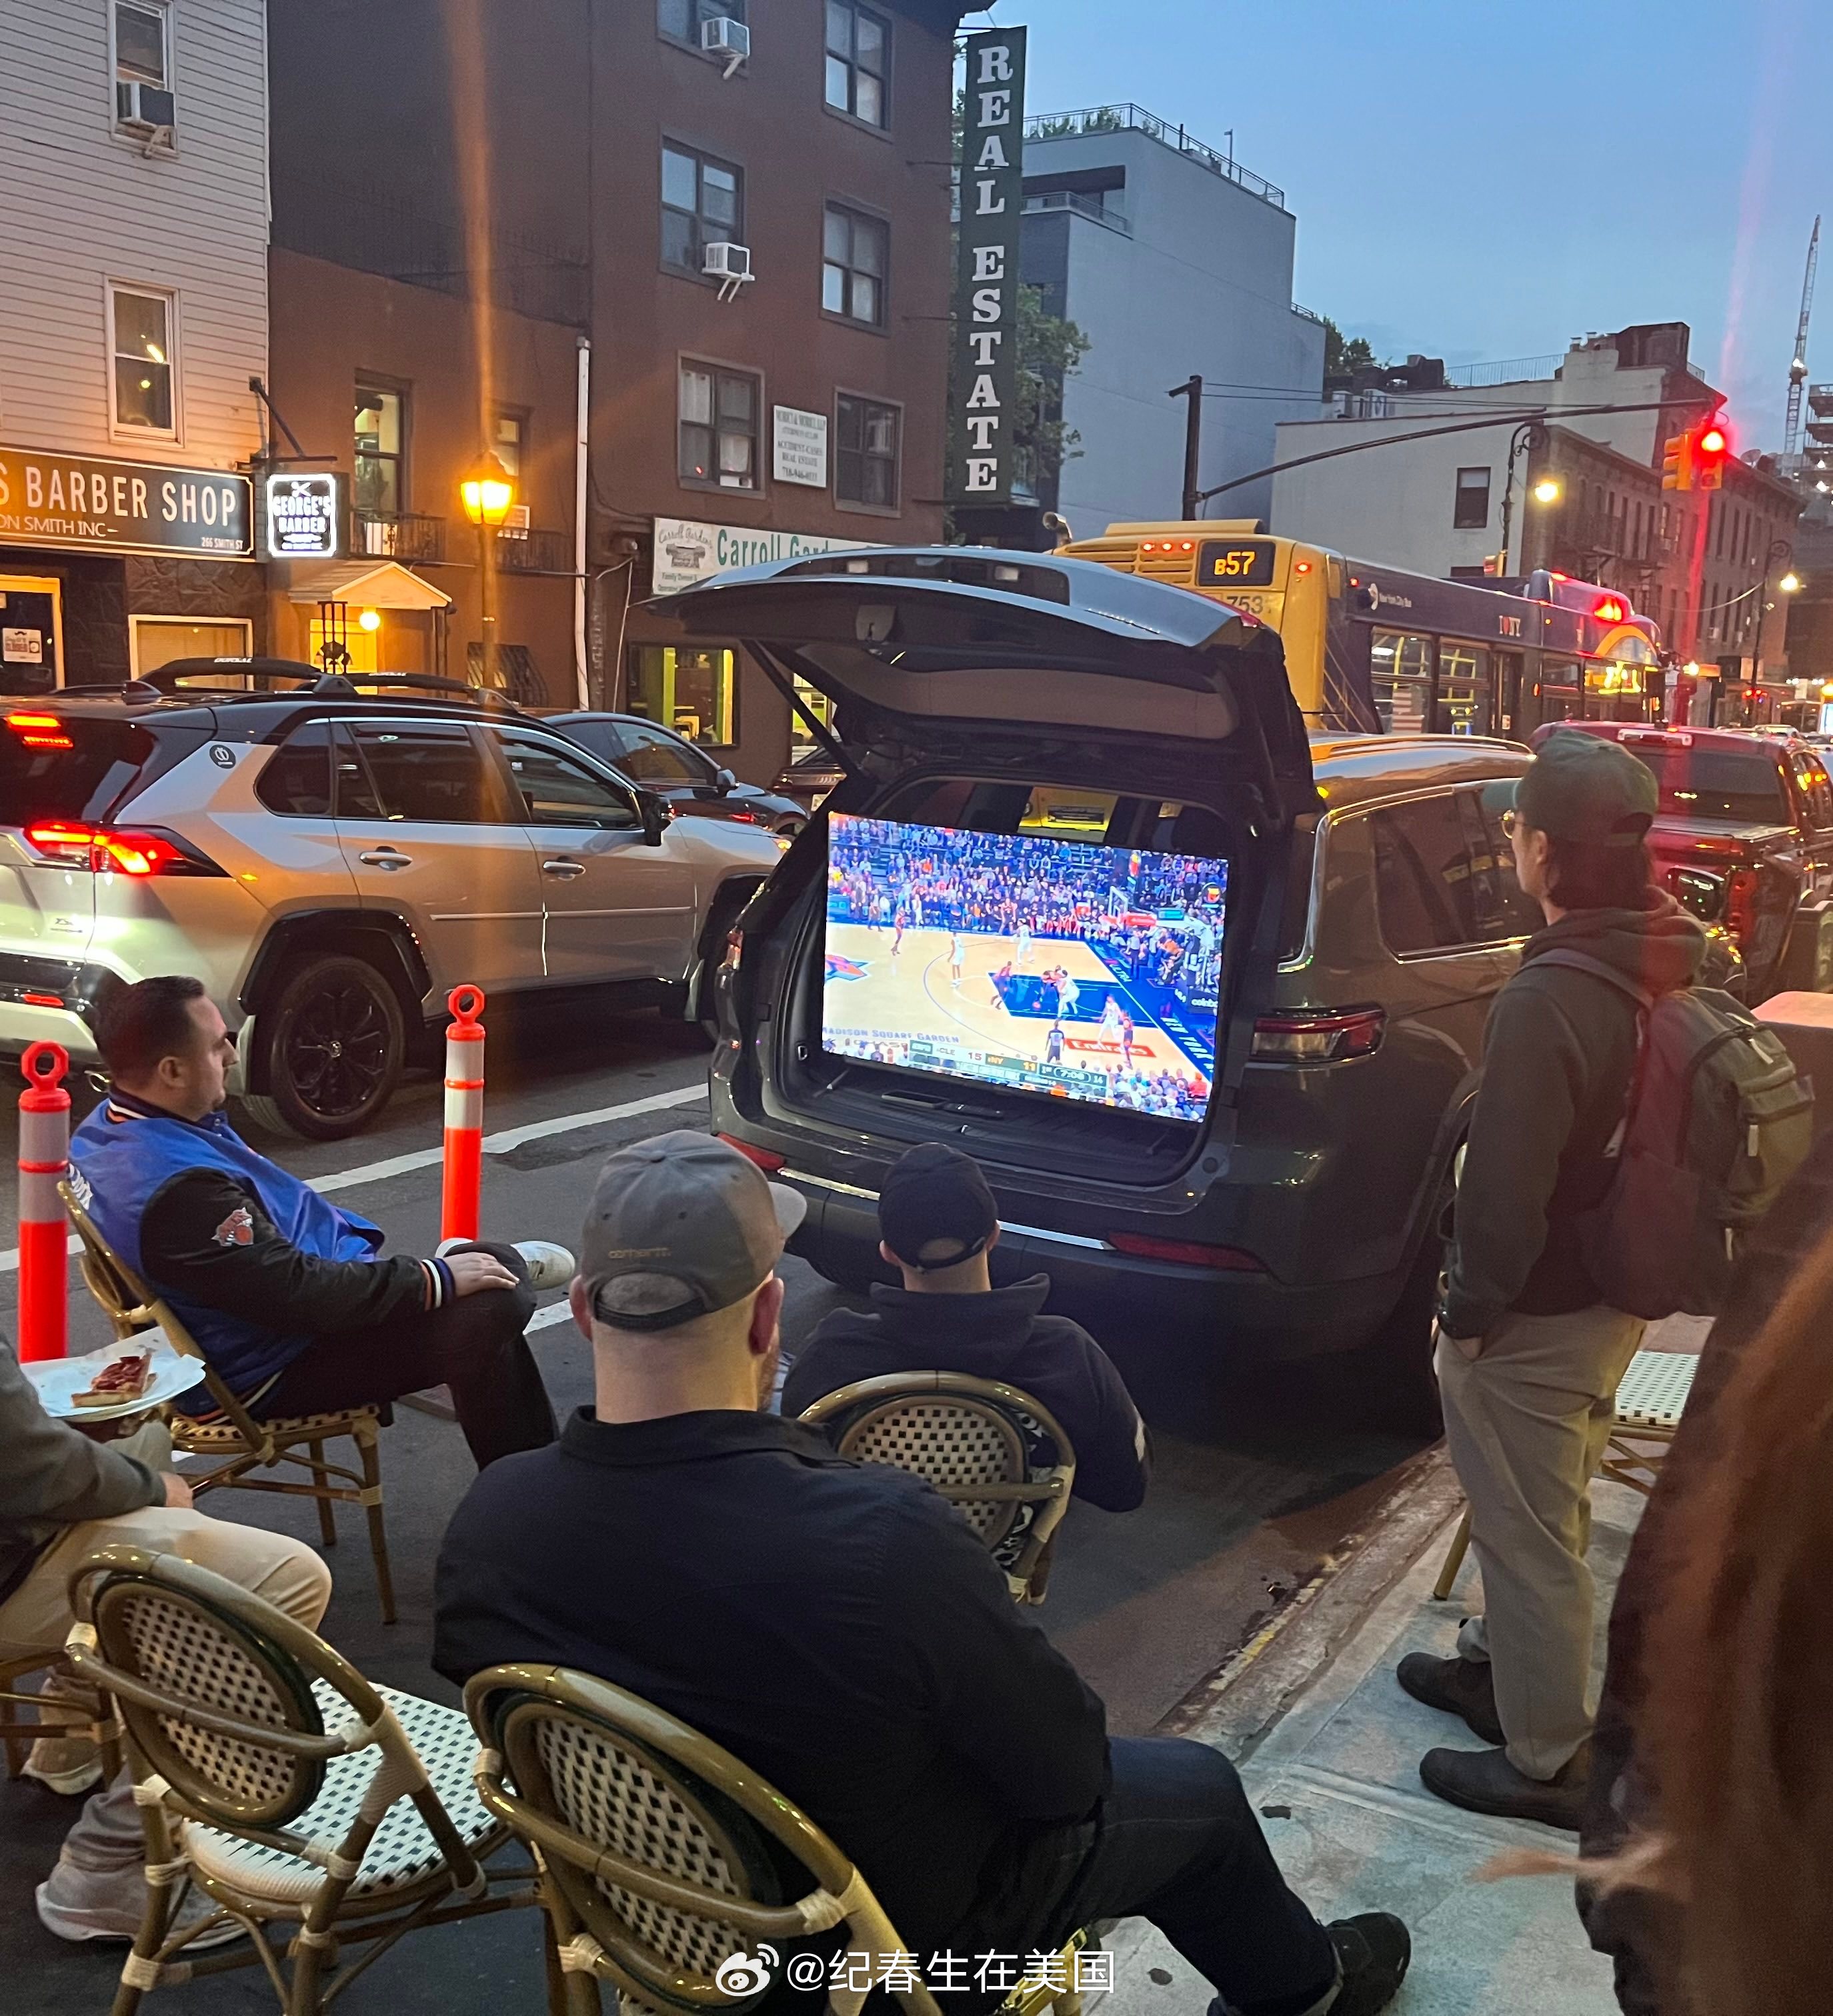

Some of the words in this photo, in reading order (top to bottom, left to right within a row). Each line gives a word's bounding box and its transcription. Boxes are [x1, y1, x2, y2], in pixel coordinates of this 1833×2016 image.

[974, 45, 1013, 215] REAL
[965, 245, 1004, 491] ESTATE
[25, 467, 148, 519] BARBER
[161, 481, 236, 527] SHOP
[272, 495, 331, 516] GEORGE'S
[24, 516, 75, 534] SMITH
[278, 517, 326, 533] BARBER
[214, 538, 235, 549] SMITH
[235, 540, 244, 549] ST
[717, 529, 780, 567] Carroll
[1214, 551, 1256, 575] B57
[917, 1033, 960, 1043] GARDEN
[969, 1052, 982, 1061] 15
[1023, 1061, 1036, 1071] 11
